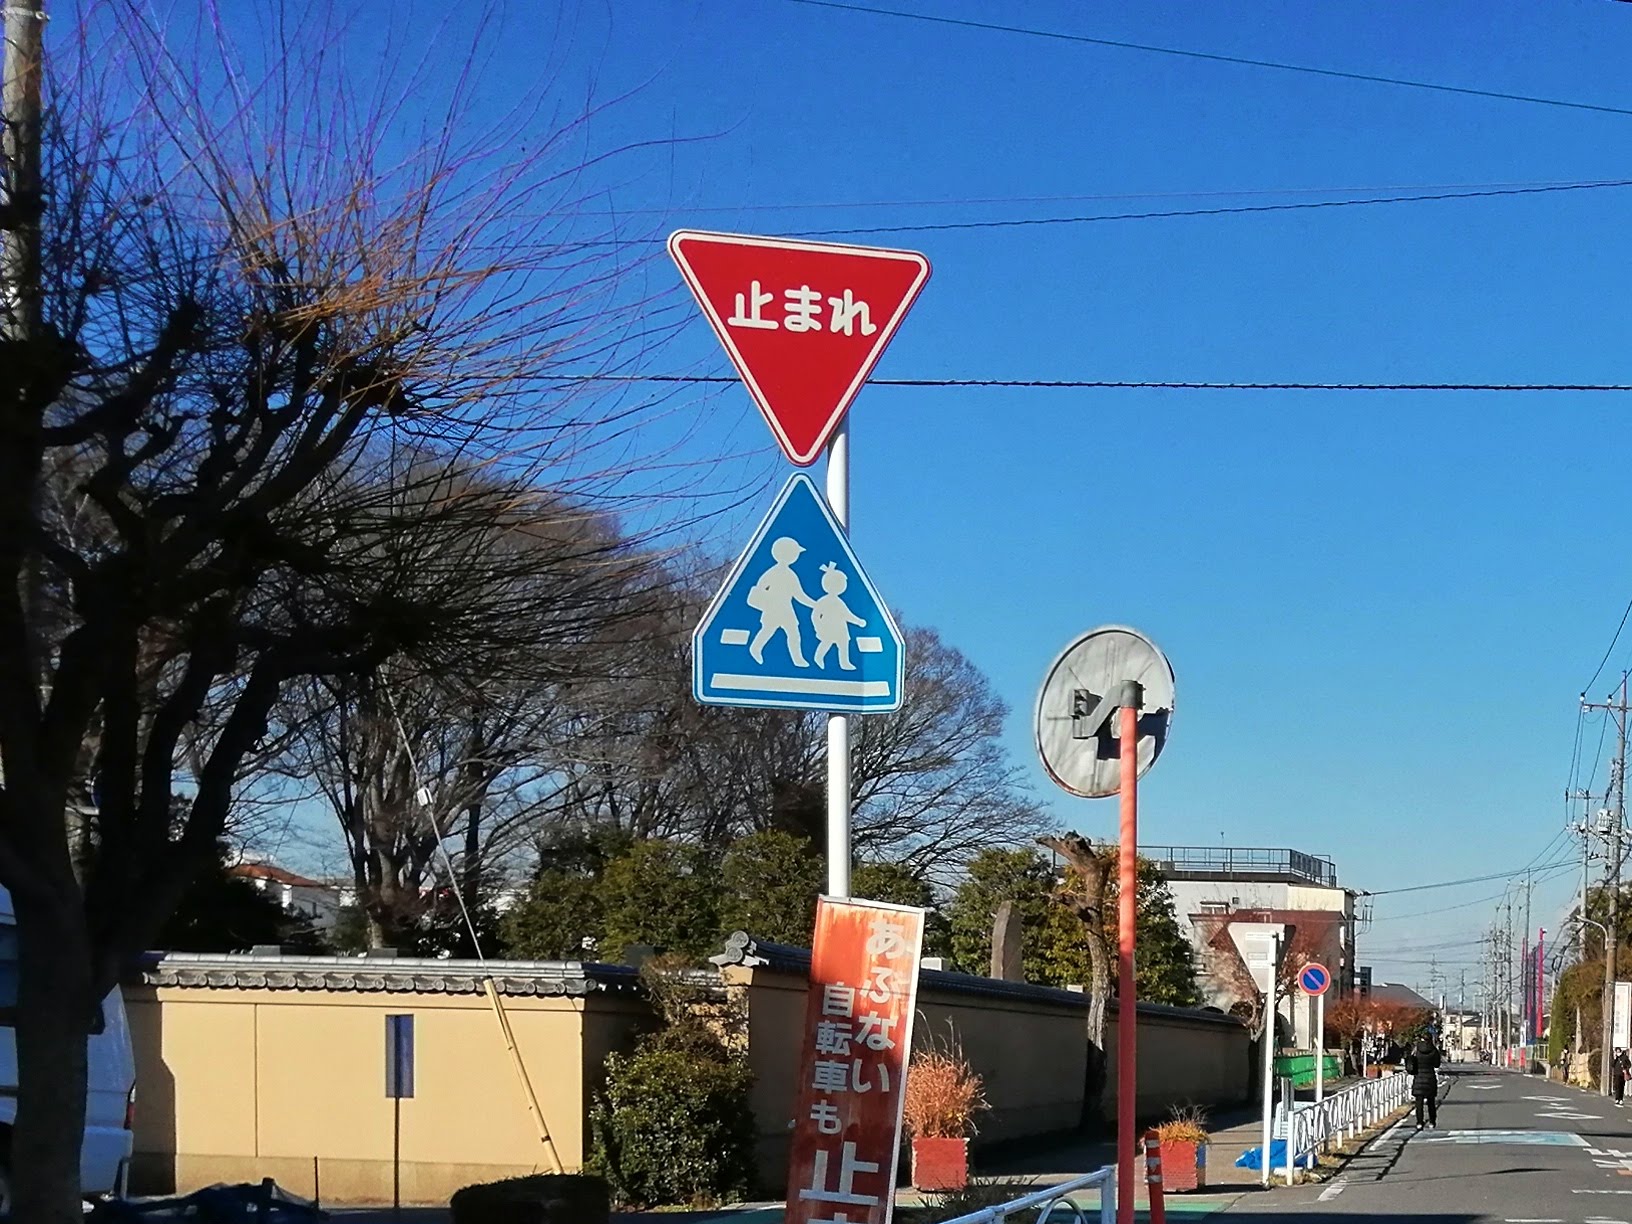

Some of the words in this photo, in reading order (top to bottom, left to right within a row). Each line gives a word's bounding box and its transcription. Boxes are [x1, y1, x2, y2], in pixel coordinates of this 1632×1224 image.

[727, 280, 877, 336] 止まれ
[810, 981, 856, 1135] 自転車も
[852, 919, 909, 1095] あぶない
